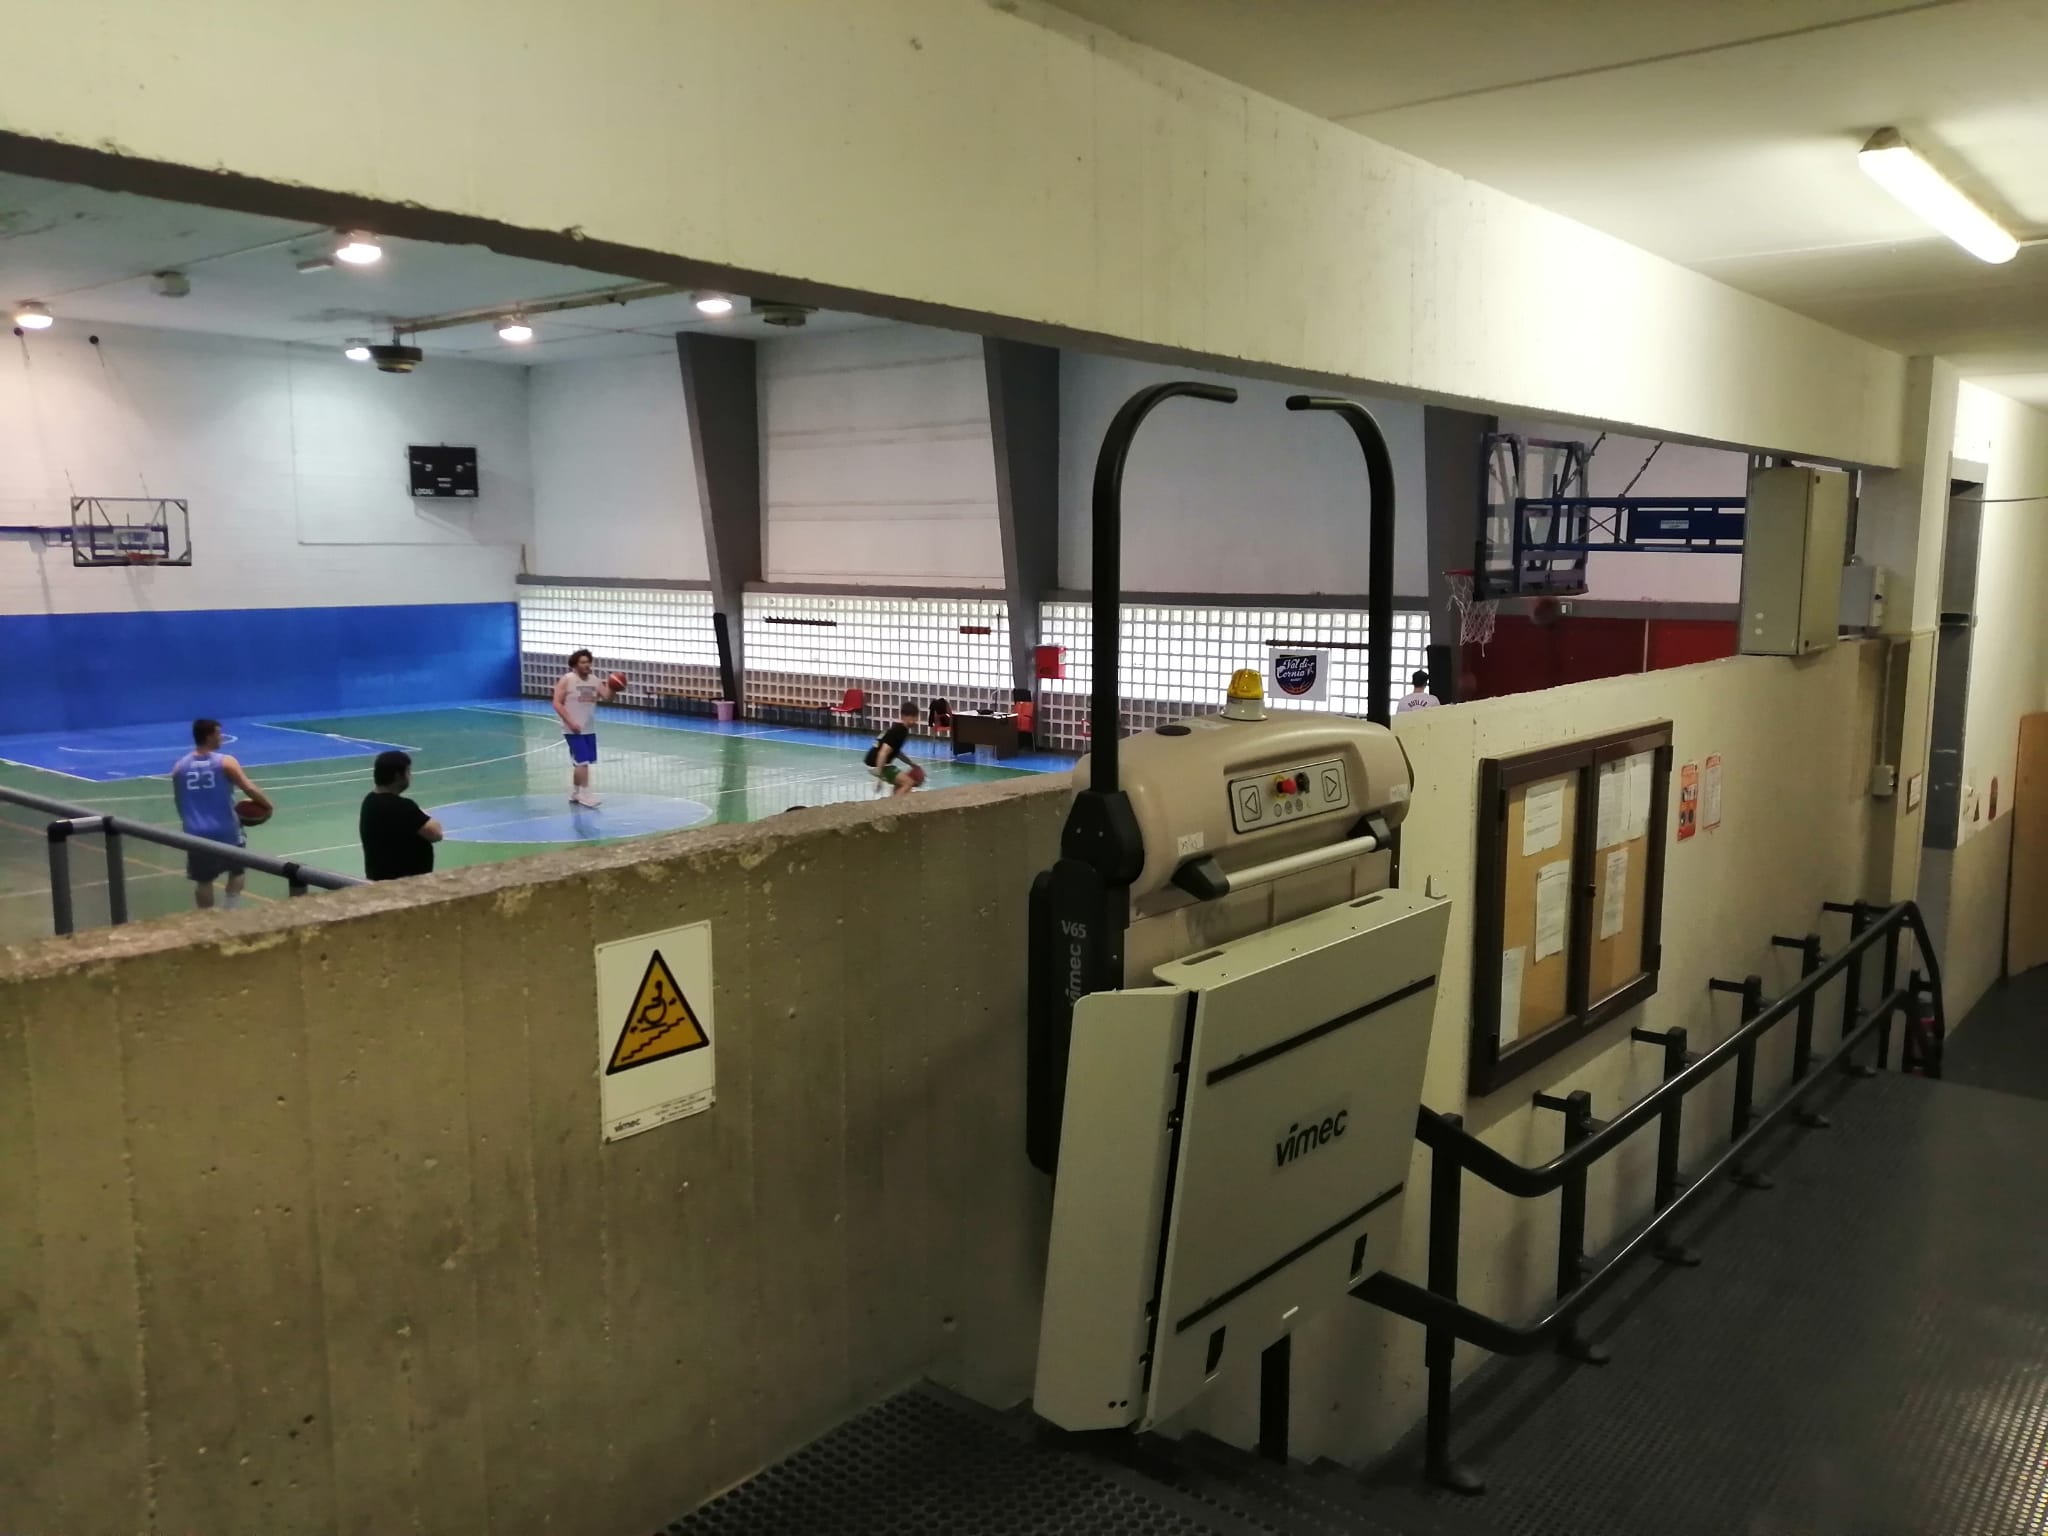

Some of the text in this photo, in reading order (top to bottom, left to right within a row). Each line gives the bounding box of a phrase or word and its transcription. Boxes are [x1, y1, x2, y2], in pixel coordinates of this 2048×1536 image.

[1277, 666, 1305, 678] Cornia
[1283, 658, 1300, 670] Val
[187, 771, 215, 790] 23
[1061, 920, 1086, 938] V65
[1065, 943, 1081, 1007] imec
[1277, 1109, 1348, 1167] vimec
